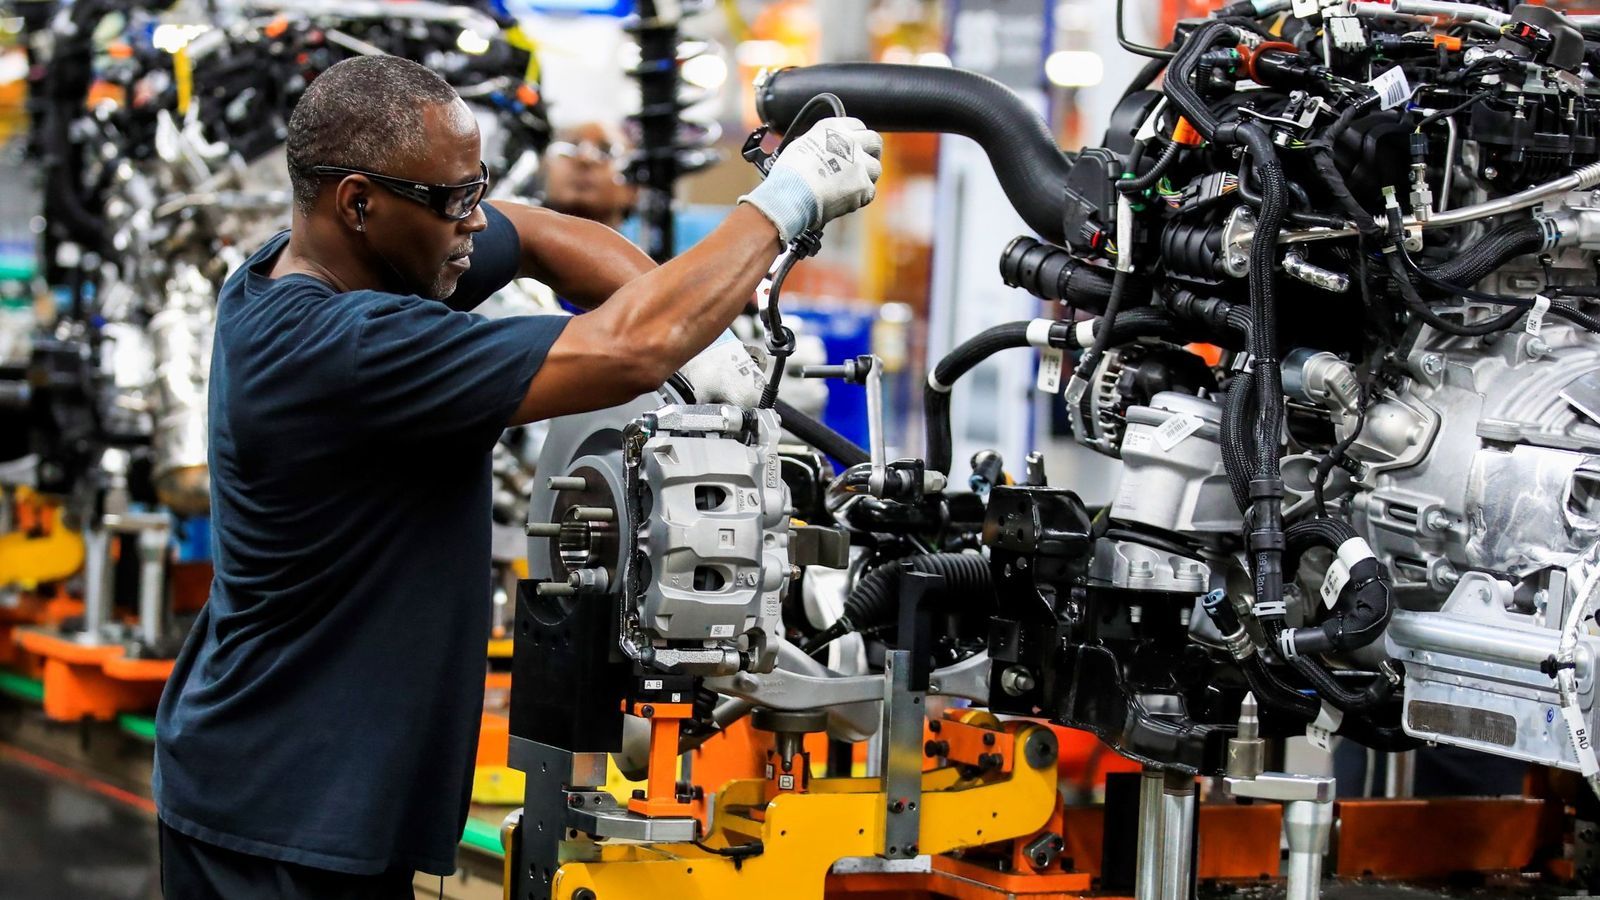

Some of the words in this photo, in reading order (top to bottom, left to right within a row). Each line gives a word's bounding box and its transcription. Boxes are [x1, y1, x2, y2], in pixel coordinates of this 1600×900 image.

[645, 681, 652, 689] A
[655, 681, 662, 689] B
[1575, 728, 1590, 751] BAD
[781, 776, 791, 787] B
